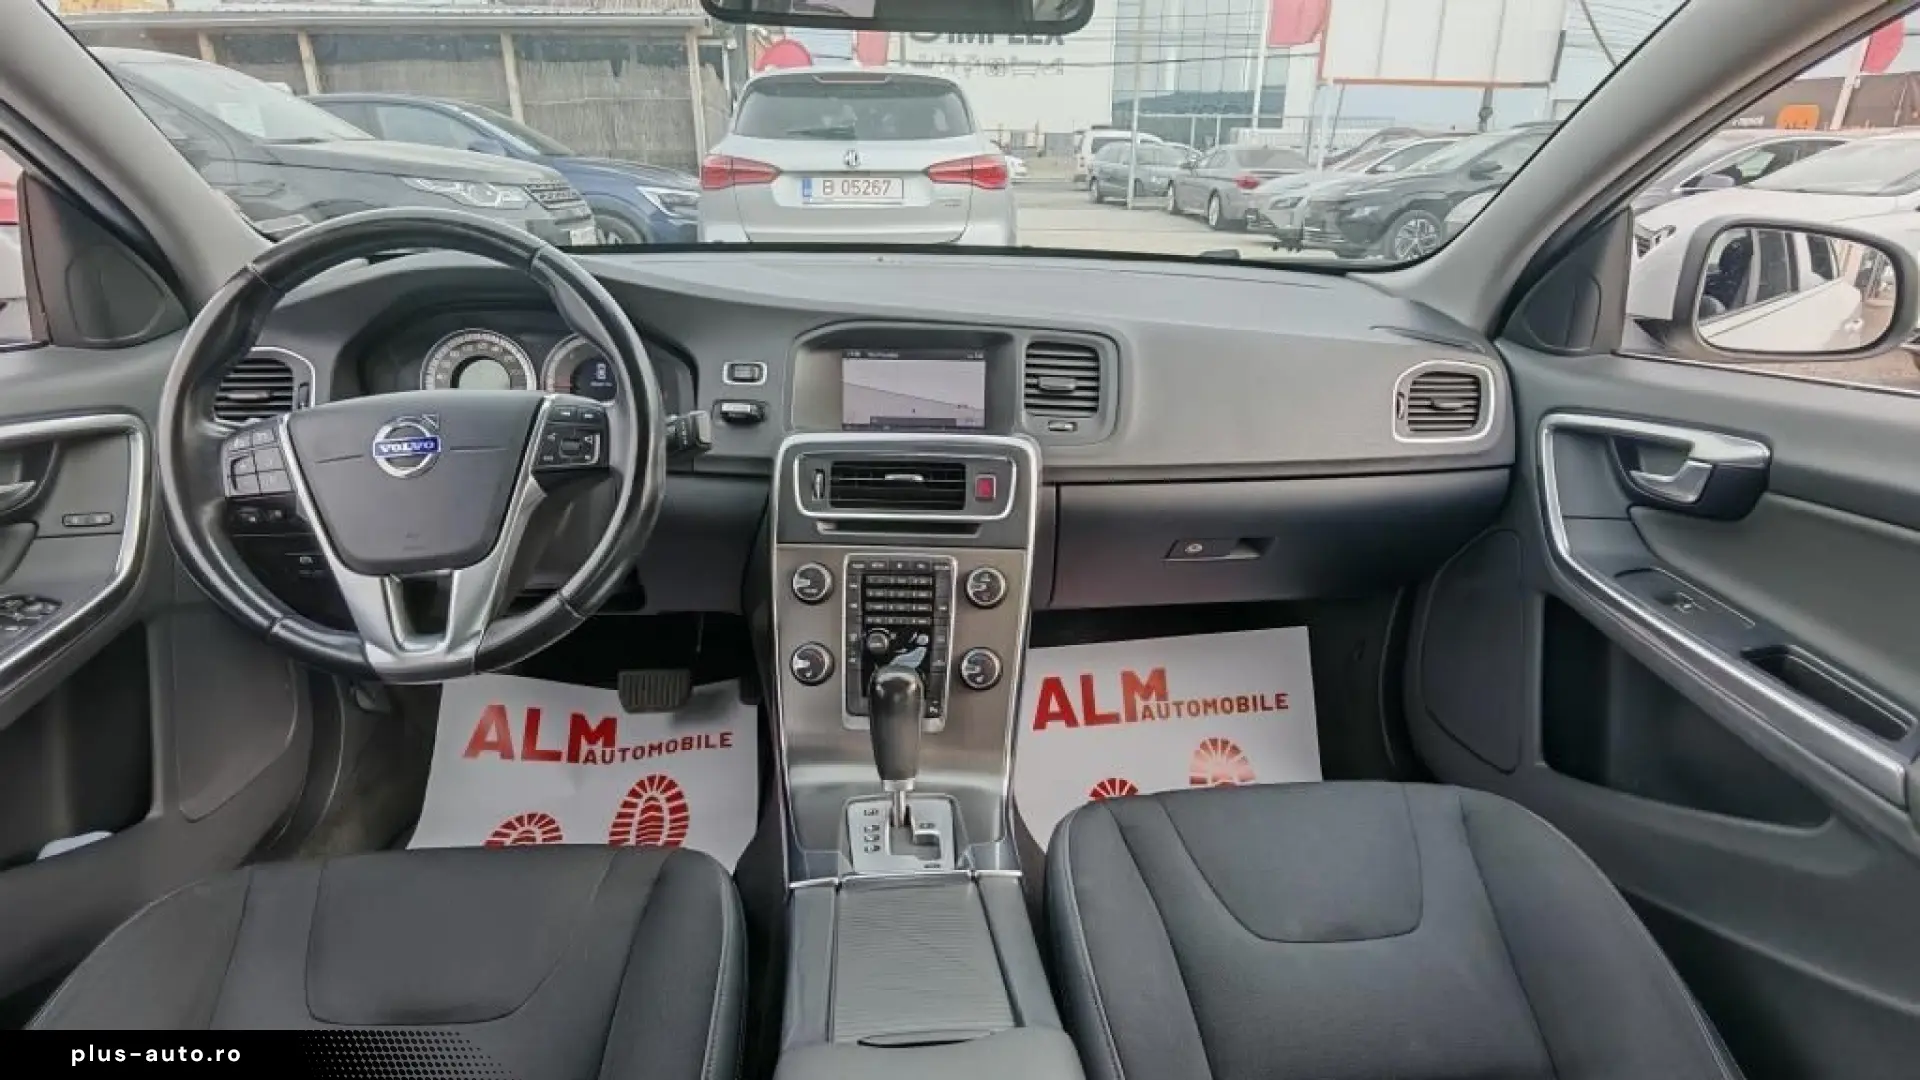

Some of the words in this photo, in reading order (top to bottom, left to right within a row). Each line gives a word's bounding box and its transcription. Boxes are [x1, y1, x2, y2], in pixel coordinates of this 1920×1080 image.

[822, 179, 835, 196] B
[841, 179, 892, 196] 05267
[379, 440, 436, 453] VOLVO
[1032, 667, 1169, 731] ALM
[1141, 692, 1290, 721] AUTOMOBILE
[463, 703, 618, 764] ALM
[582, 731, 734, 765] AUTOMOBILE
